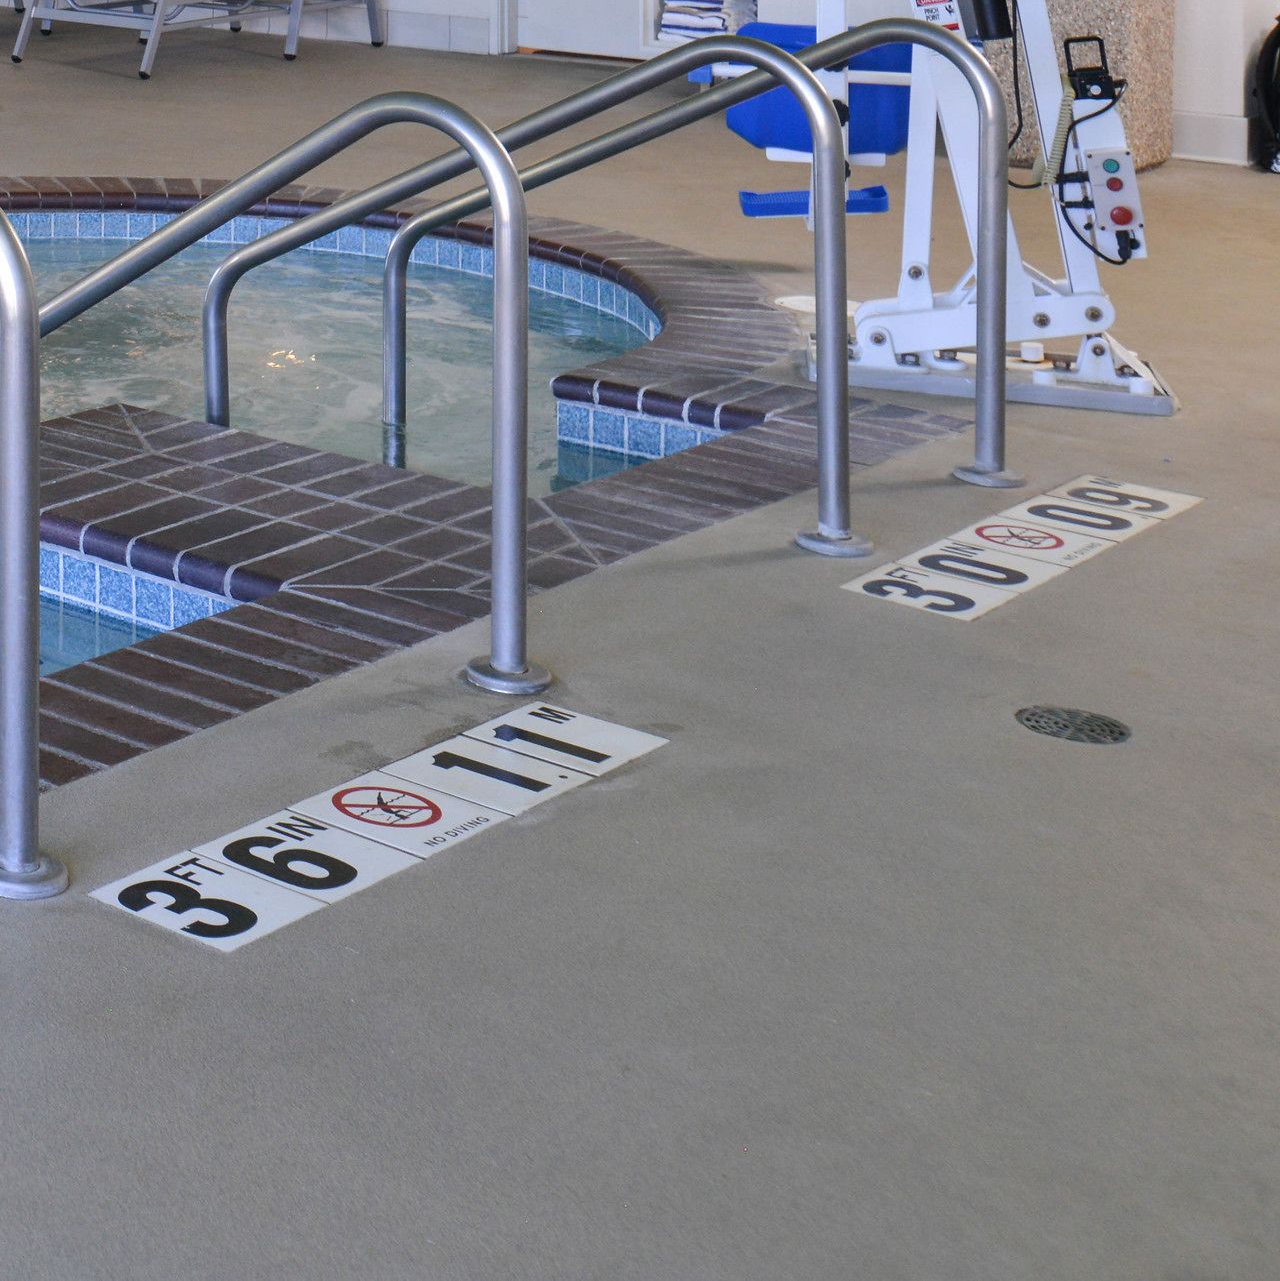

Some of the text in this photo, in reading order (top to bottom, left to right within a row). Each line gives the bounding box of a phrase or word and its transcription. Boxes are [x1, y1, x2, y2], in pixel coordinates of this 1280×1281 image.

[940, 542, 985, 558] IN
[885, 568, 928, 585] FT
[918, 554, 1029, 586] 0
[862, 579, 976, 613] 3
[528, 707, 577, 725] M
[268, 816, 329, 842] IN
[423, 815, 490, 847] NO DIVING
[163, 857, 224, 887] FT
[223, 835, 358, 890] 6
[118, 879, 258, 939] 3
